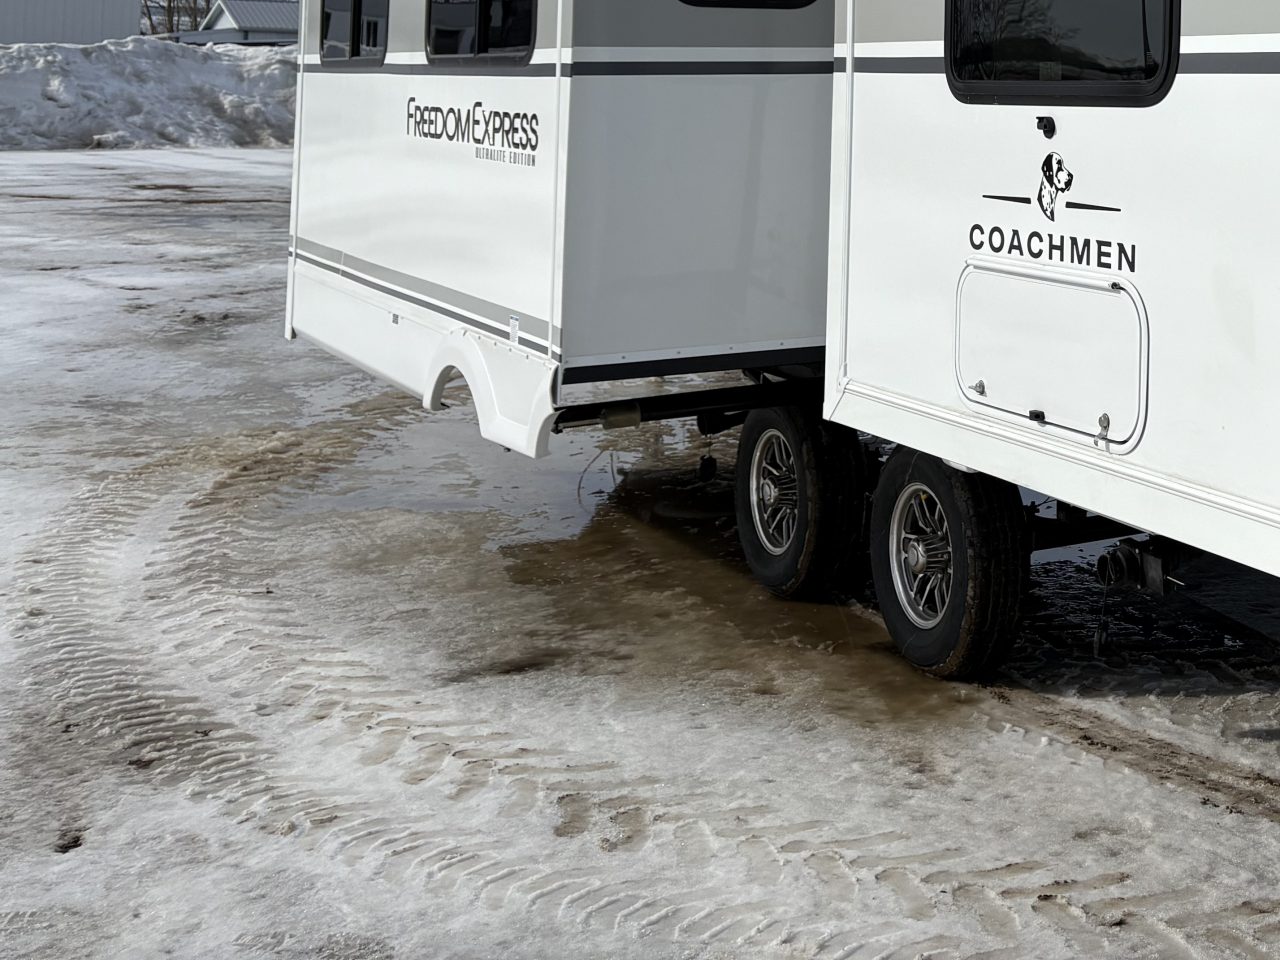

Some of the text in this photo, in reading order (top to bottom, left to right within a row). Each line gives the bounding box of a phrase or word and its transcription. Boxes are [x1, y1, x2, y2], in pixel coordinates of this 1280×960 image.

[475, 146, 536, 167] ULTRALITE EDITION
[969, 223, 1136, 273] COACHMEN
